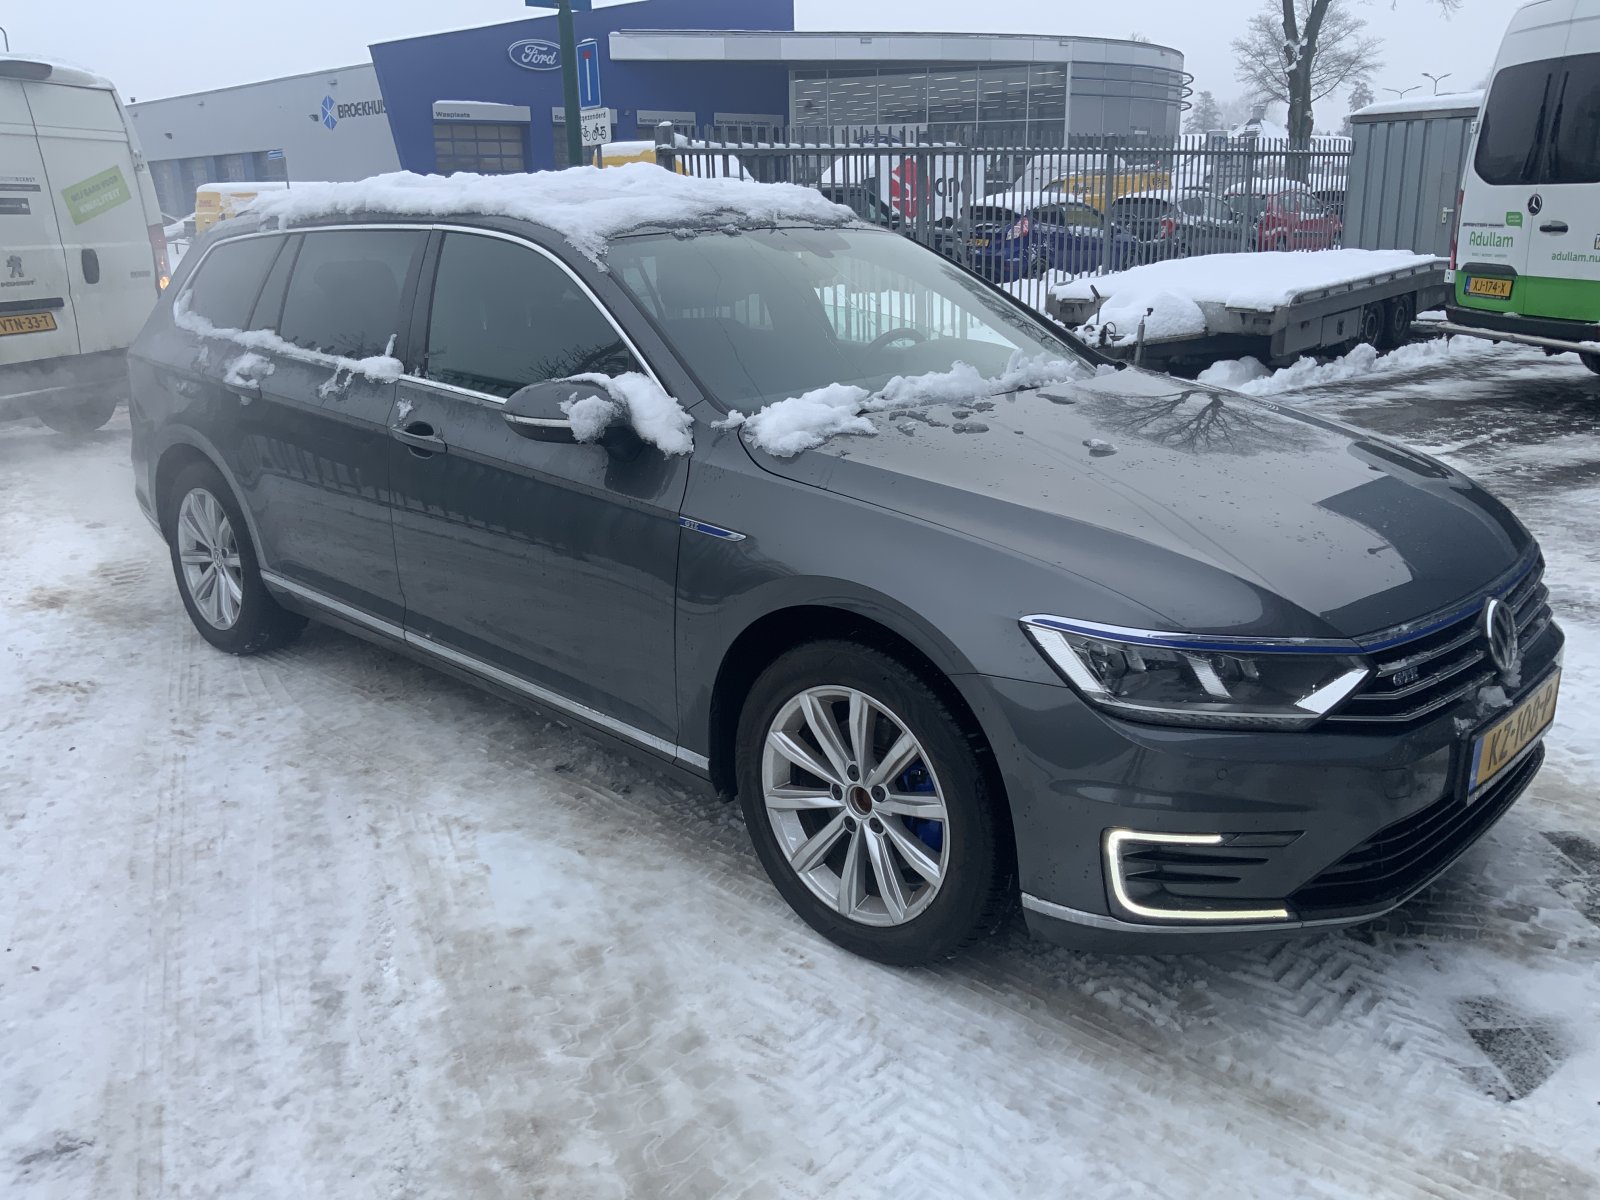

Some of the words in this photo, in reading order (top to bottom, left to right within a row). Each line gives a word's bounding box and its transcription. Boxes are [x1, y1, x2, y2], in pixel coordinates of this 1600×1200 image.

[521, 45, 557, 65] Ford
[581, 112, 606, 123] gezonderd
[1469, 231, 1514, 248] Adullam
[1551, 251, 1600, 263] adullam.nu
[1472, 279, 1507, 294] XJ-174-X
[0, 315, 50, 332] VTN-33-T
[1487, 683, 1553, 771] KZ-108-P
